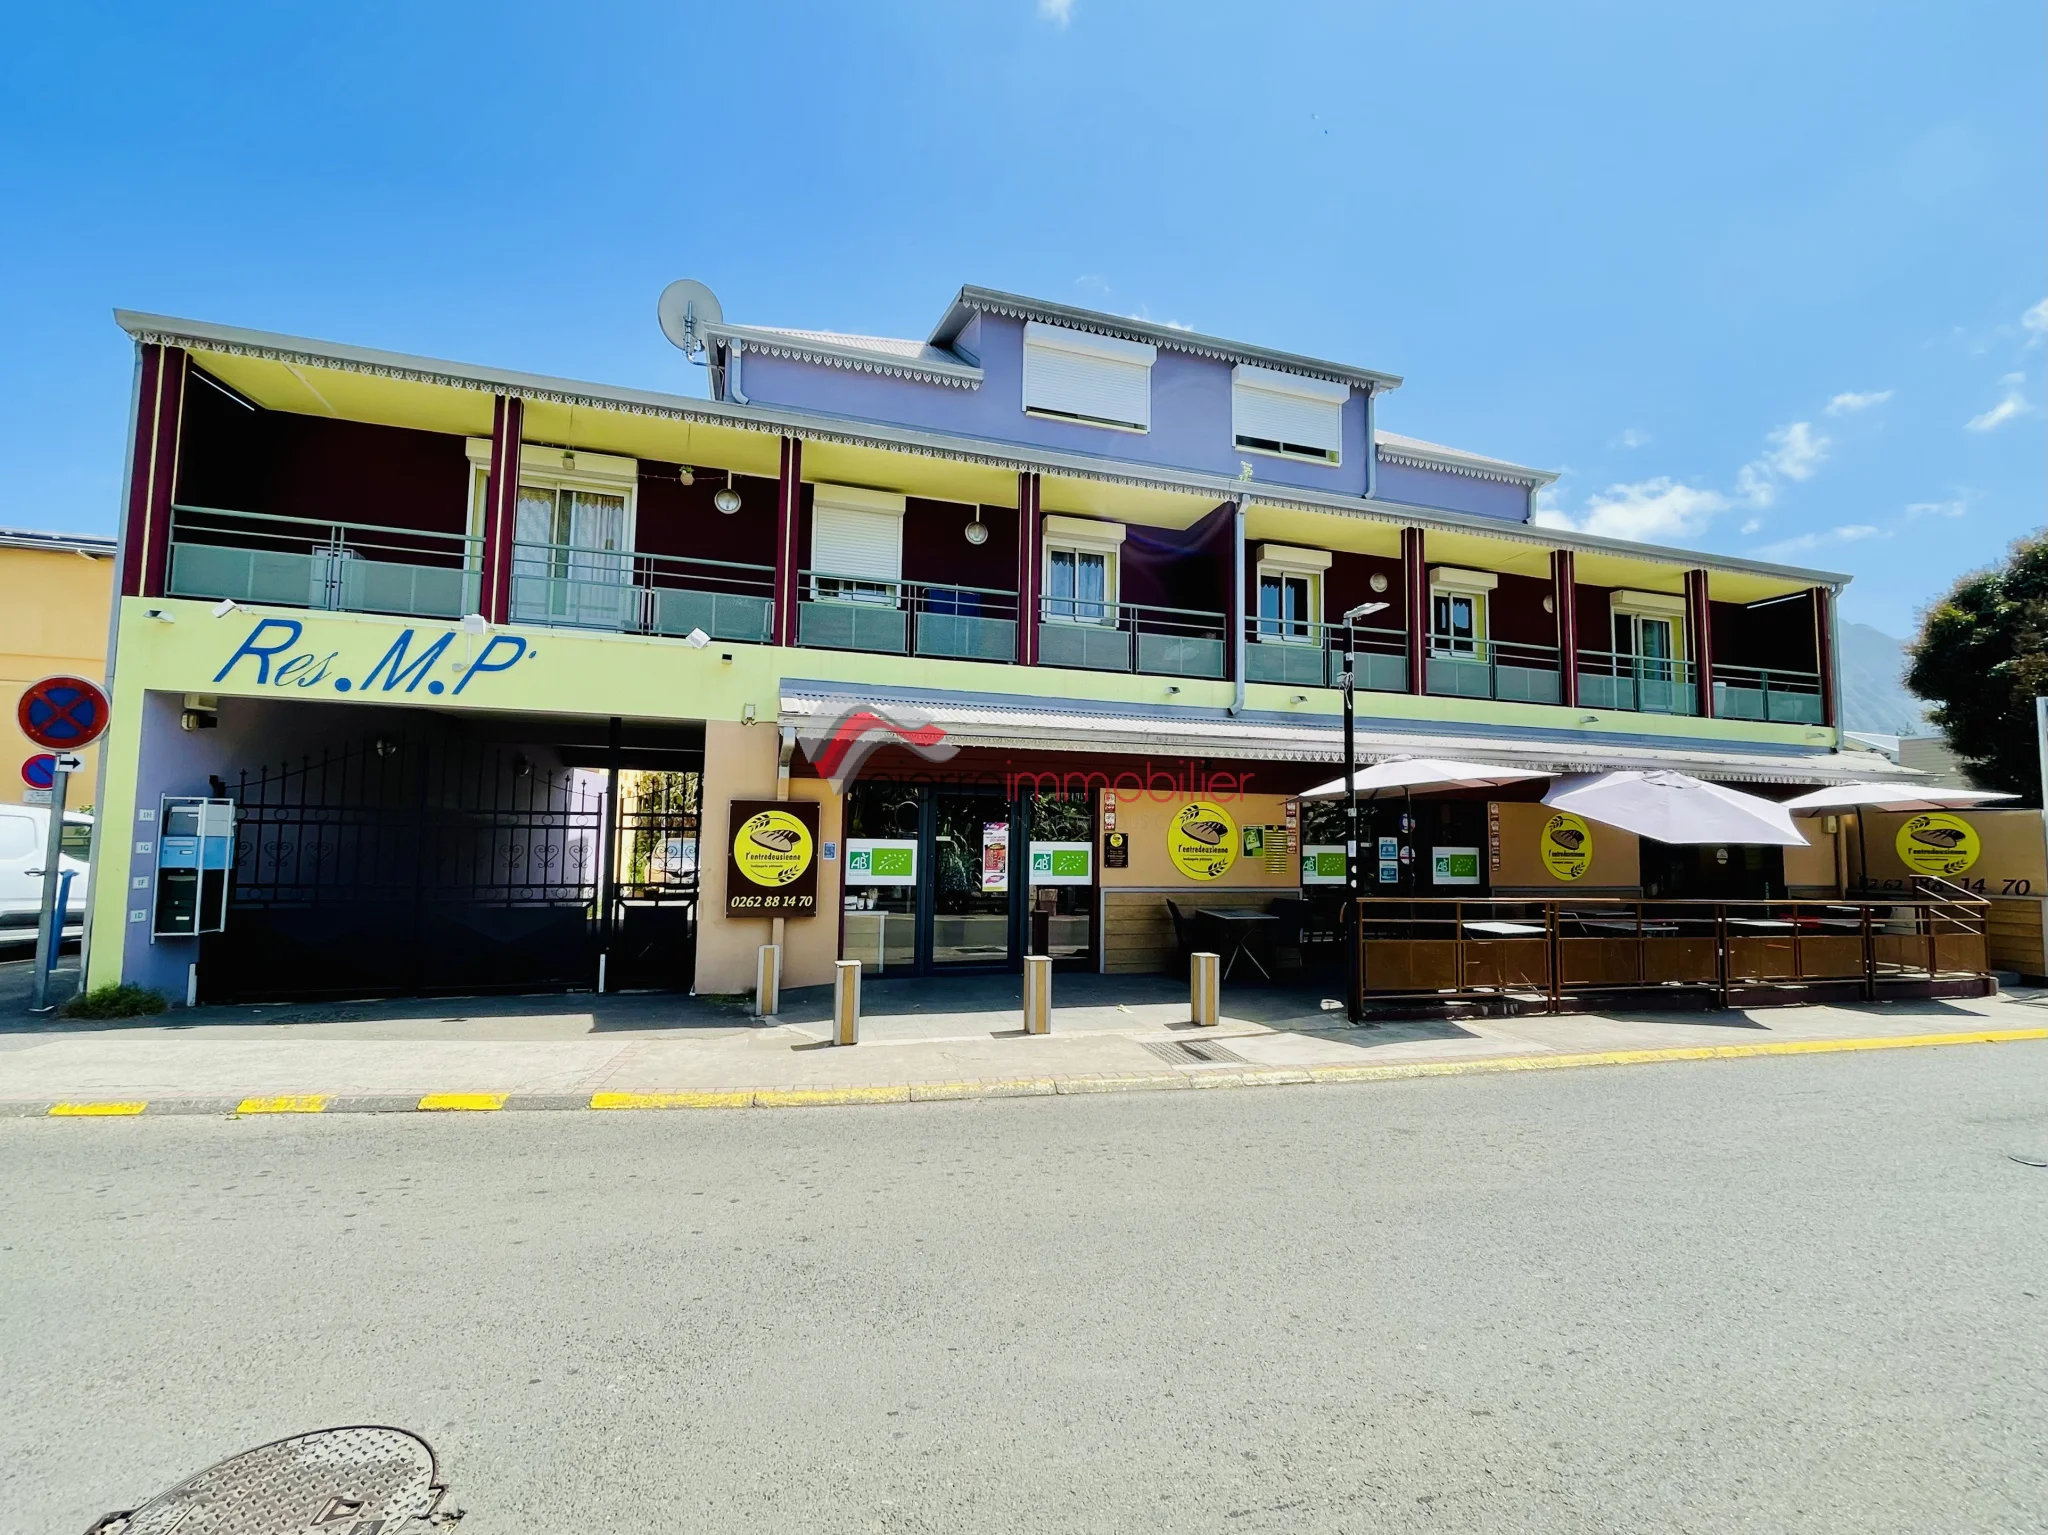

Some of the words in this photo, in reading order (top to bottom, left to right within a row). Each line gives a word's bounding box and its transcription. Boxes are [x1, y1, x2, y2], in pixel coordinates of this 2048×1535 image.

[851, 856, 868, 869] AB
[1034, 858, 1049, 870] AB
[1960, 878, 1986, 895] 14
[2002, 879, 2031, 896] 70
[731, 895, 762, 907] 0262
[764, 895, 780, 907] 88
[782, 895, 797, 907] 14
[798, 895, 813, 907] 70
